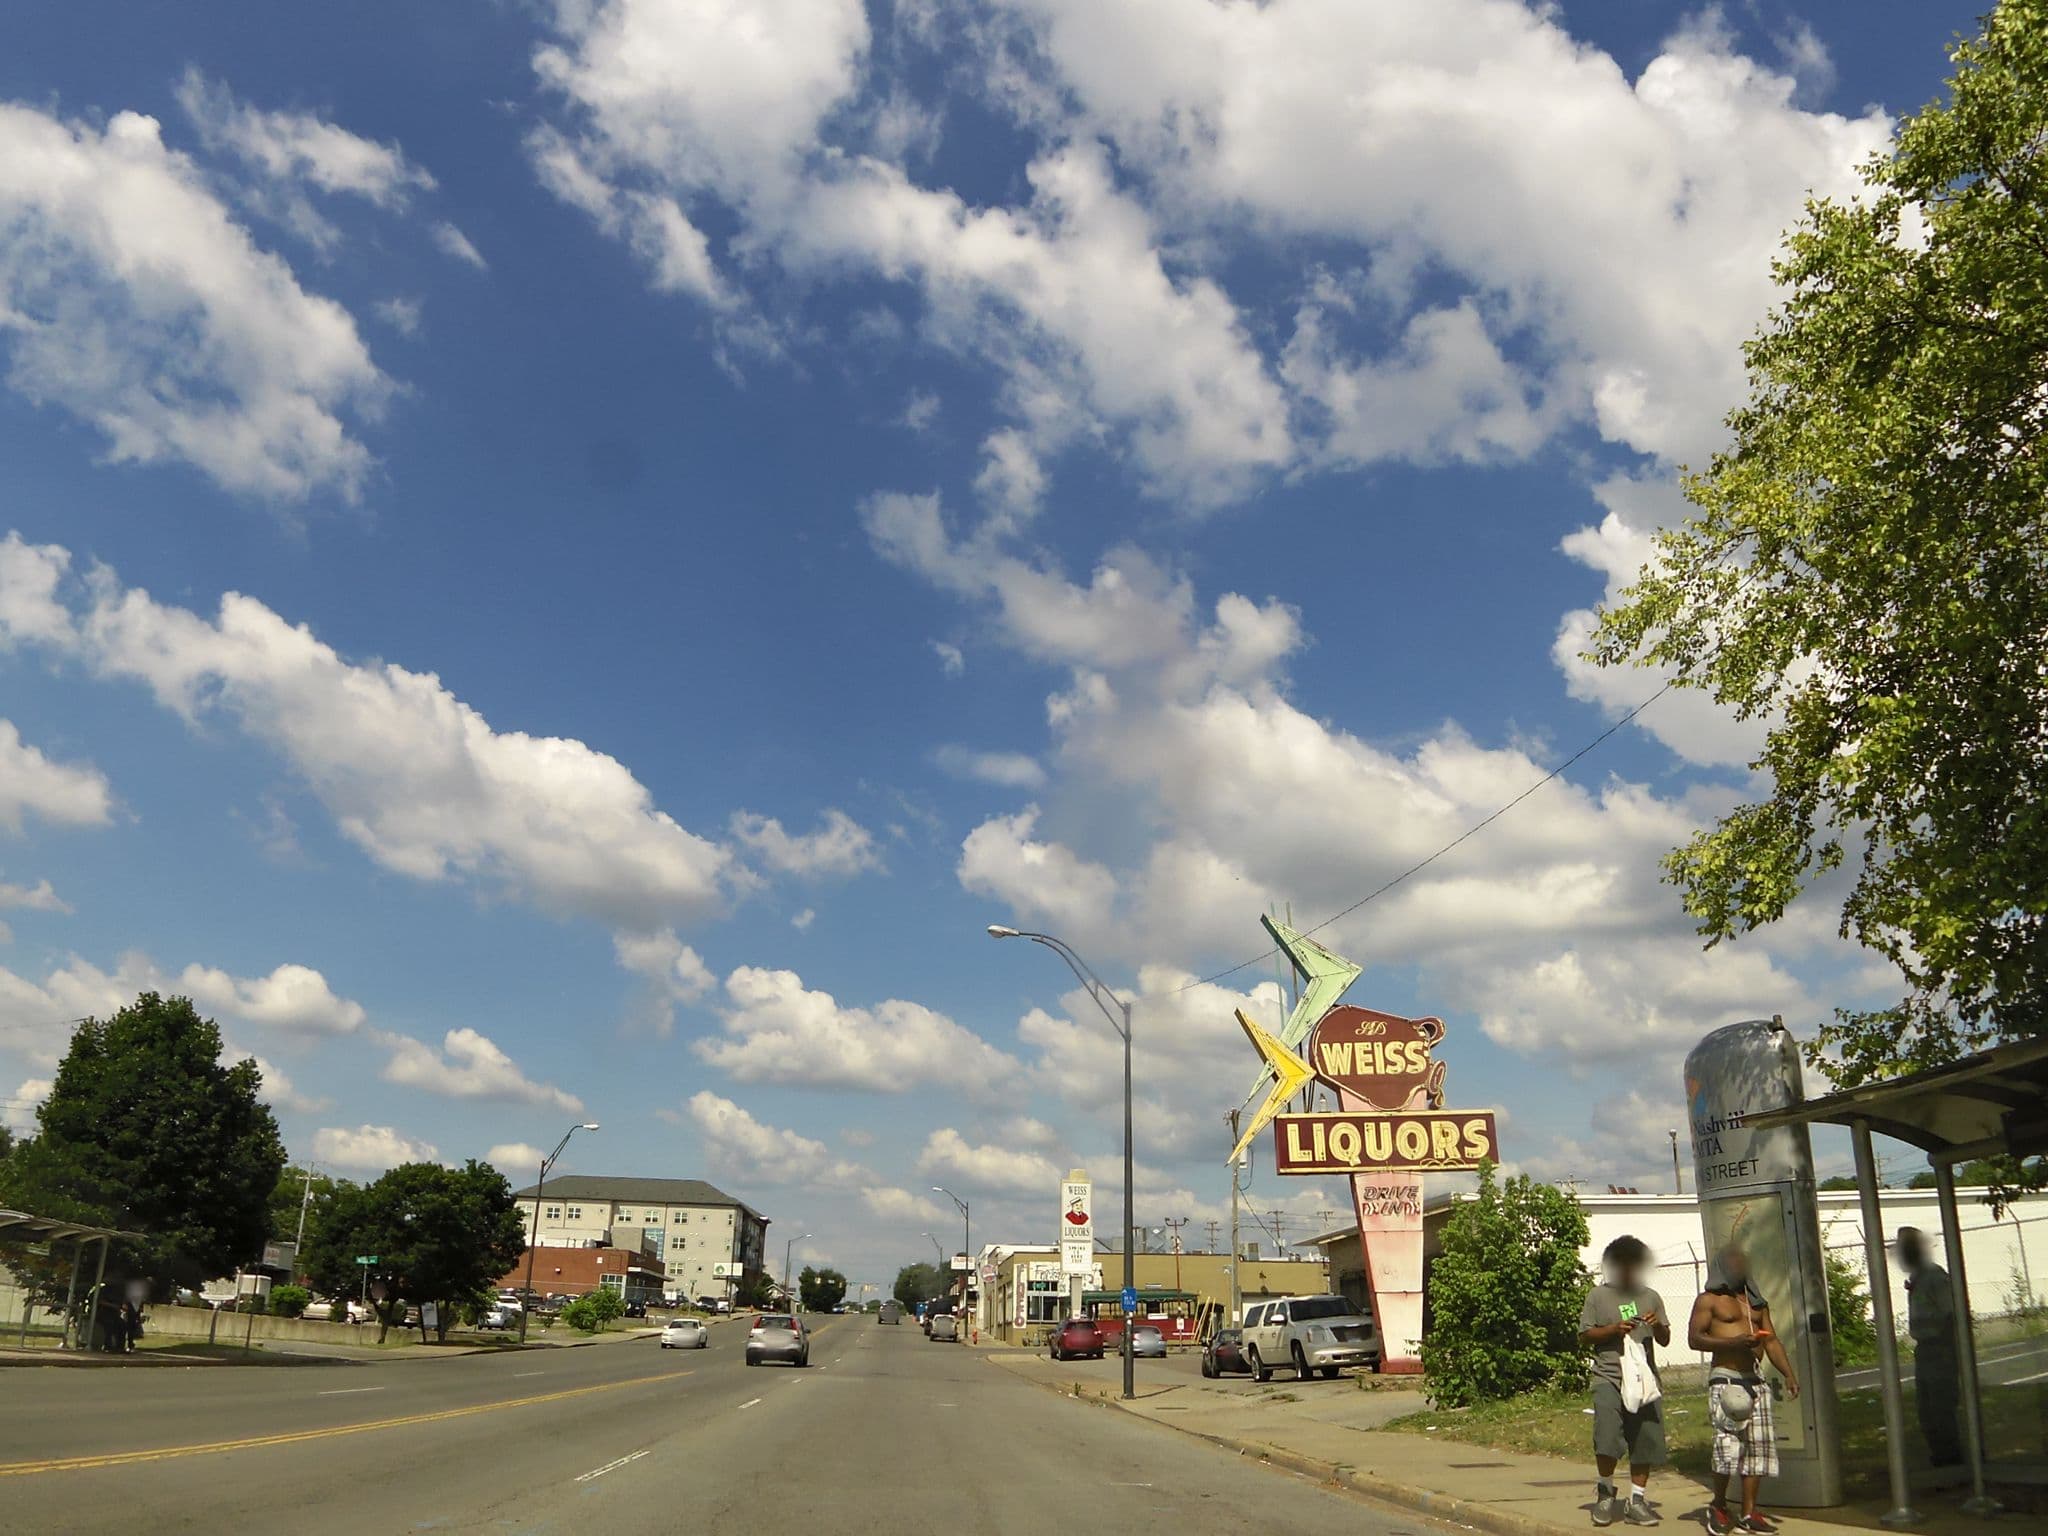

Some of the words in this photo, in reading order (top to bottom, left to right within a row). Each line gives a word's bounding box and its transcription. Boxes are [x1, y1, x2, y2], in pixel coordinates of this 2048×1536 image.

[1320, 1041, 1427, 1076] WEISS
[1286, 1119, 1490, 1167] LIQUORS
[1705, 1160, 1758, 1181] STREET
[1068, 1185, 1087, 1196] WEISS
[1364, 1186, 1419, 1201] DRIVE
[1064, 1226, 1090, 1238] LIQUORS
